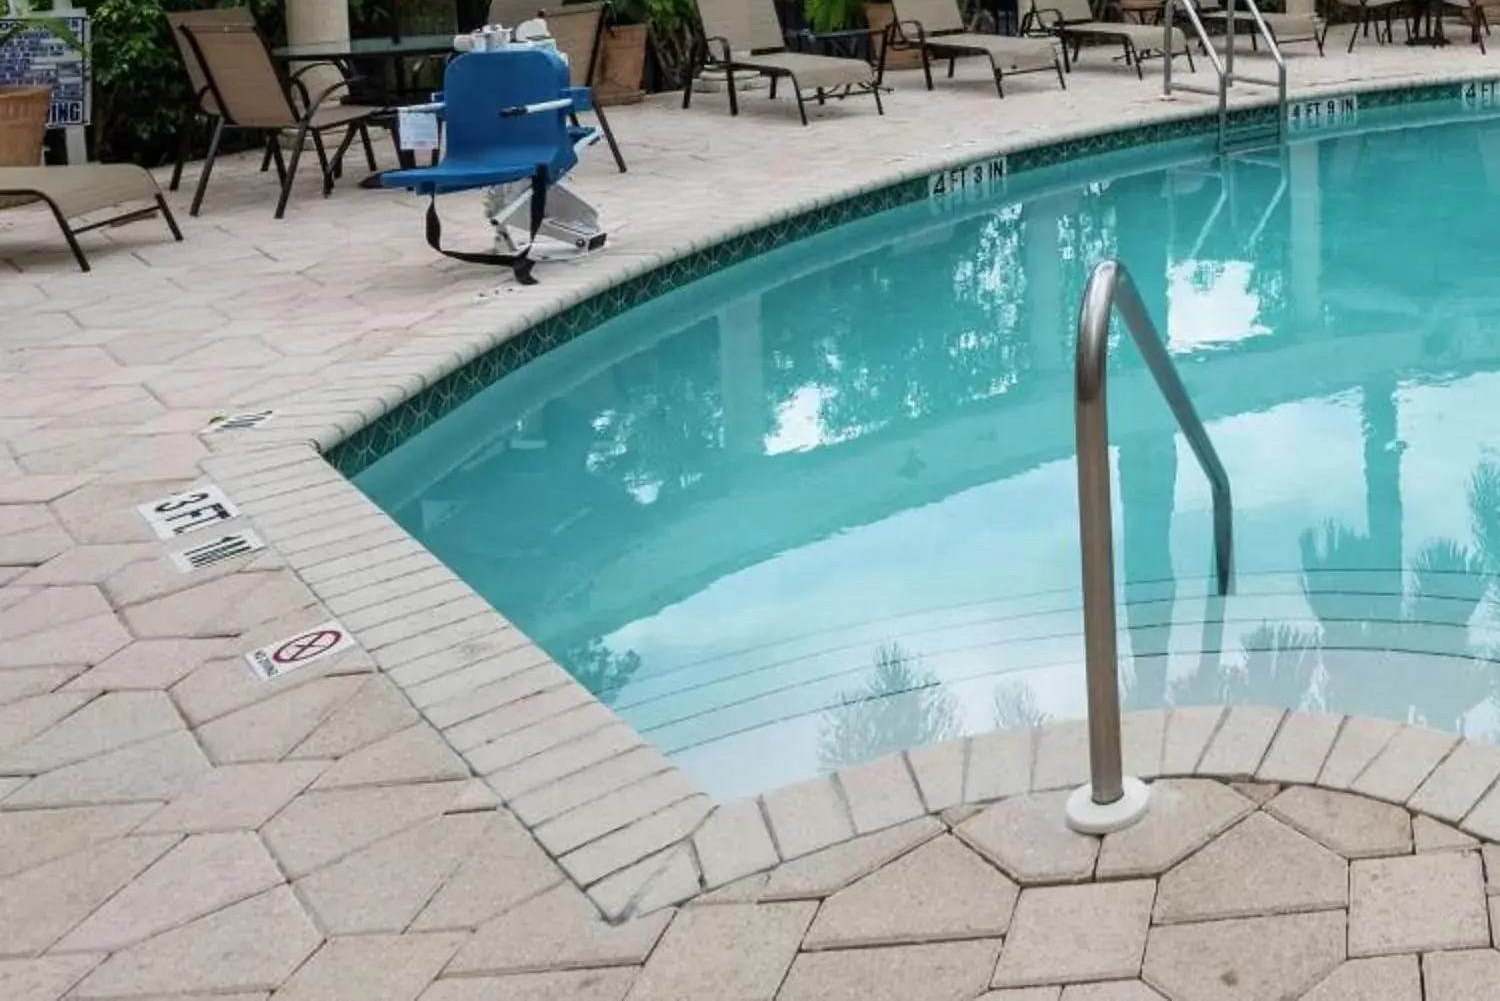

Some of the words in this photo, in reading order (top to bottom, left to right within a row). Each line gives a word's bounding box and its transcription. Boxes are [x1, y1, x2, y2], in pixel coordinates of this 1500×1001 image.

[1464, 82, 1476, 97] 4
[934, 174, 945, 194] 4
[951, 167, 968, 192] FT
[989, 158, 1003, 180] IN
[155, 492, 209, 512] 3
[165, 502, 231, 534] FT
